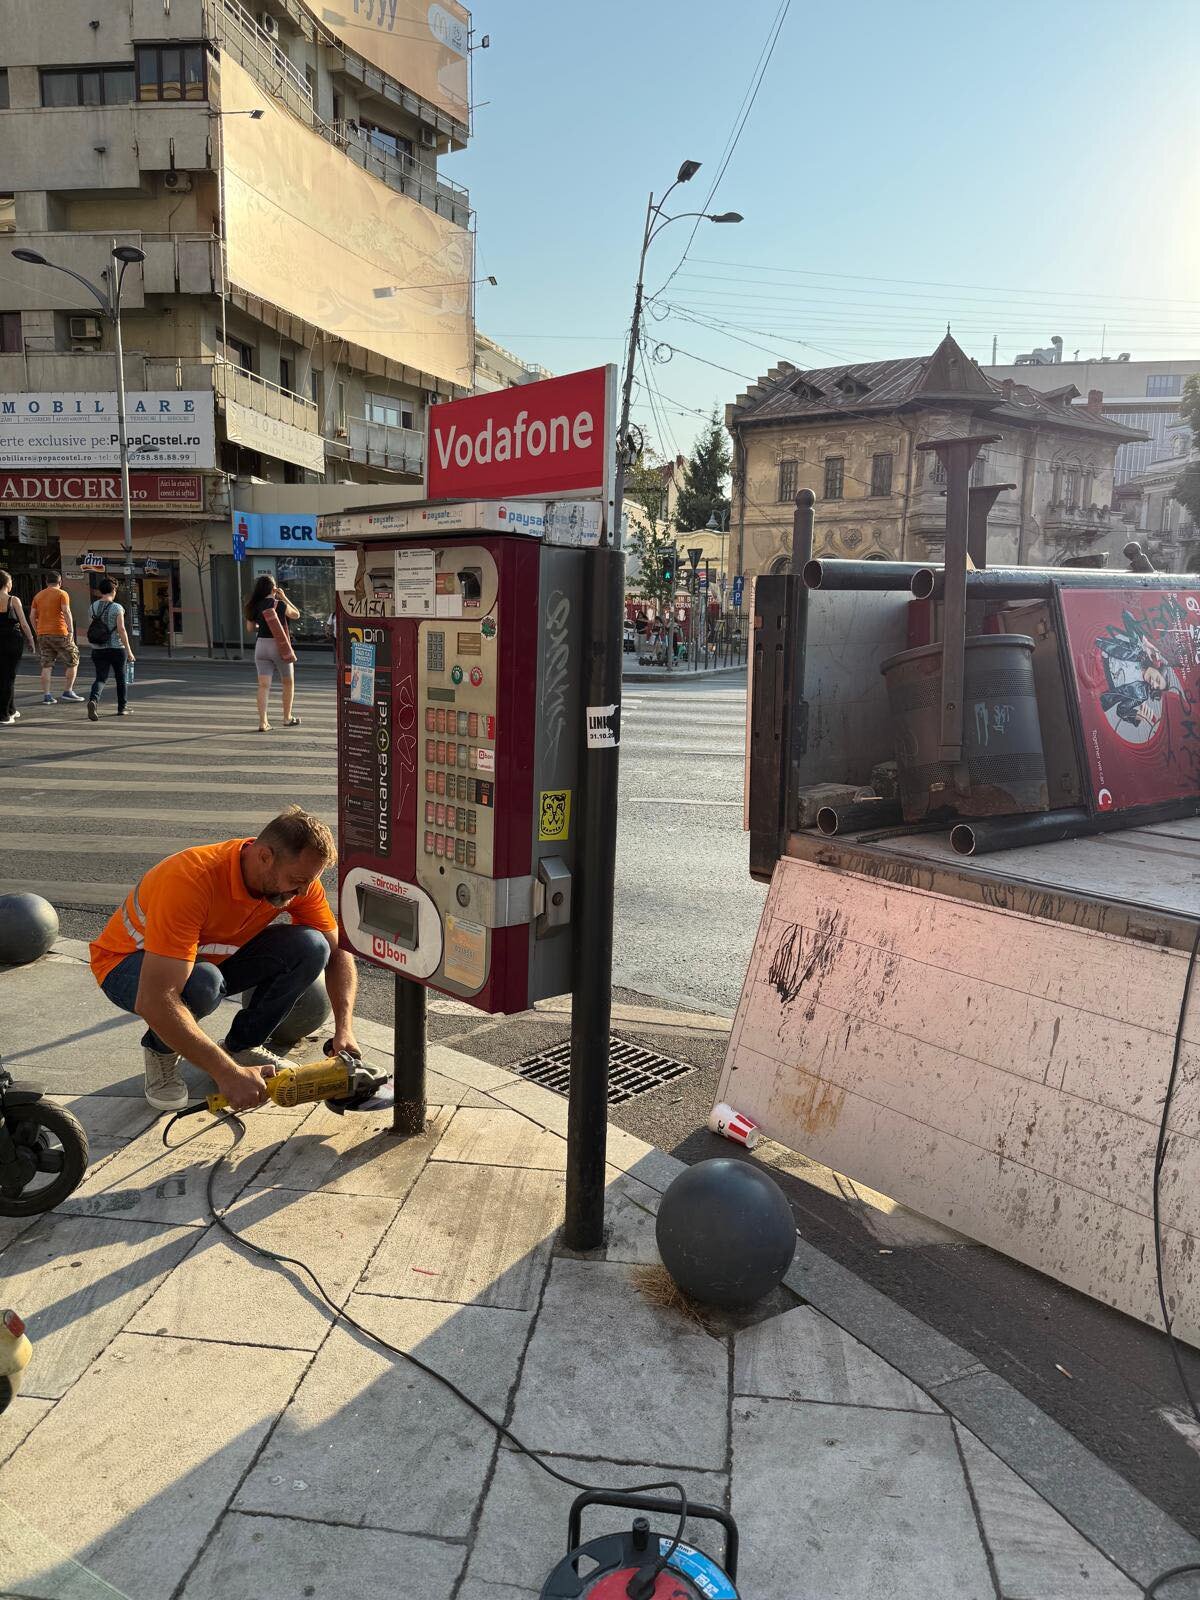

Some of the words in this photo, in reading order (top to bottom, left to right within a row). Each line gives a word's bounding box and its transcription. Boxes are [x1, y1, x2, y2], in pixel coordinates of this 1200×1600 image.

[2, 400, 195, 414] MOBILARE
[0, 436, 24, 447] erte
[28, 435, 87, 447] exclusive
[110, 434, 200, 448] PpaCostel.ro
[434, 410, 594, 470] Vodafone
[280, 526, 313, 541] BCR
[85, 553, 103, 566] dm
[363, 628, 385, 643] pin
[376, 876, 403, 895] aircash
